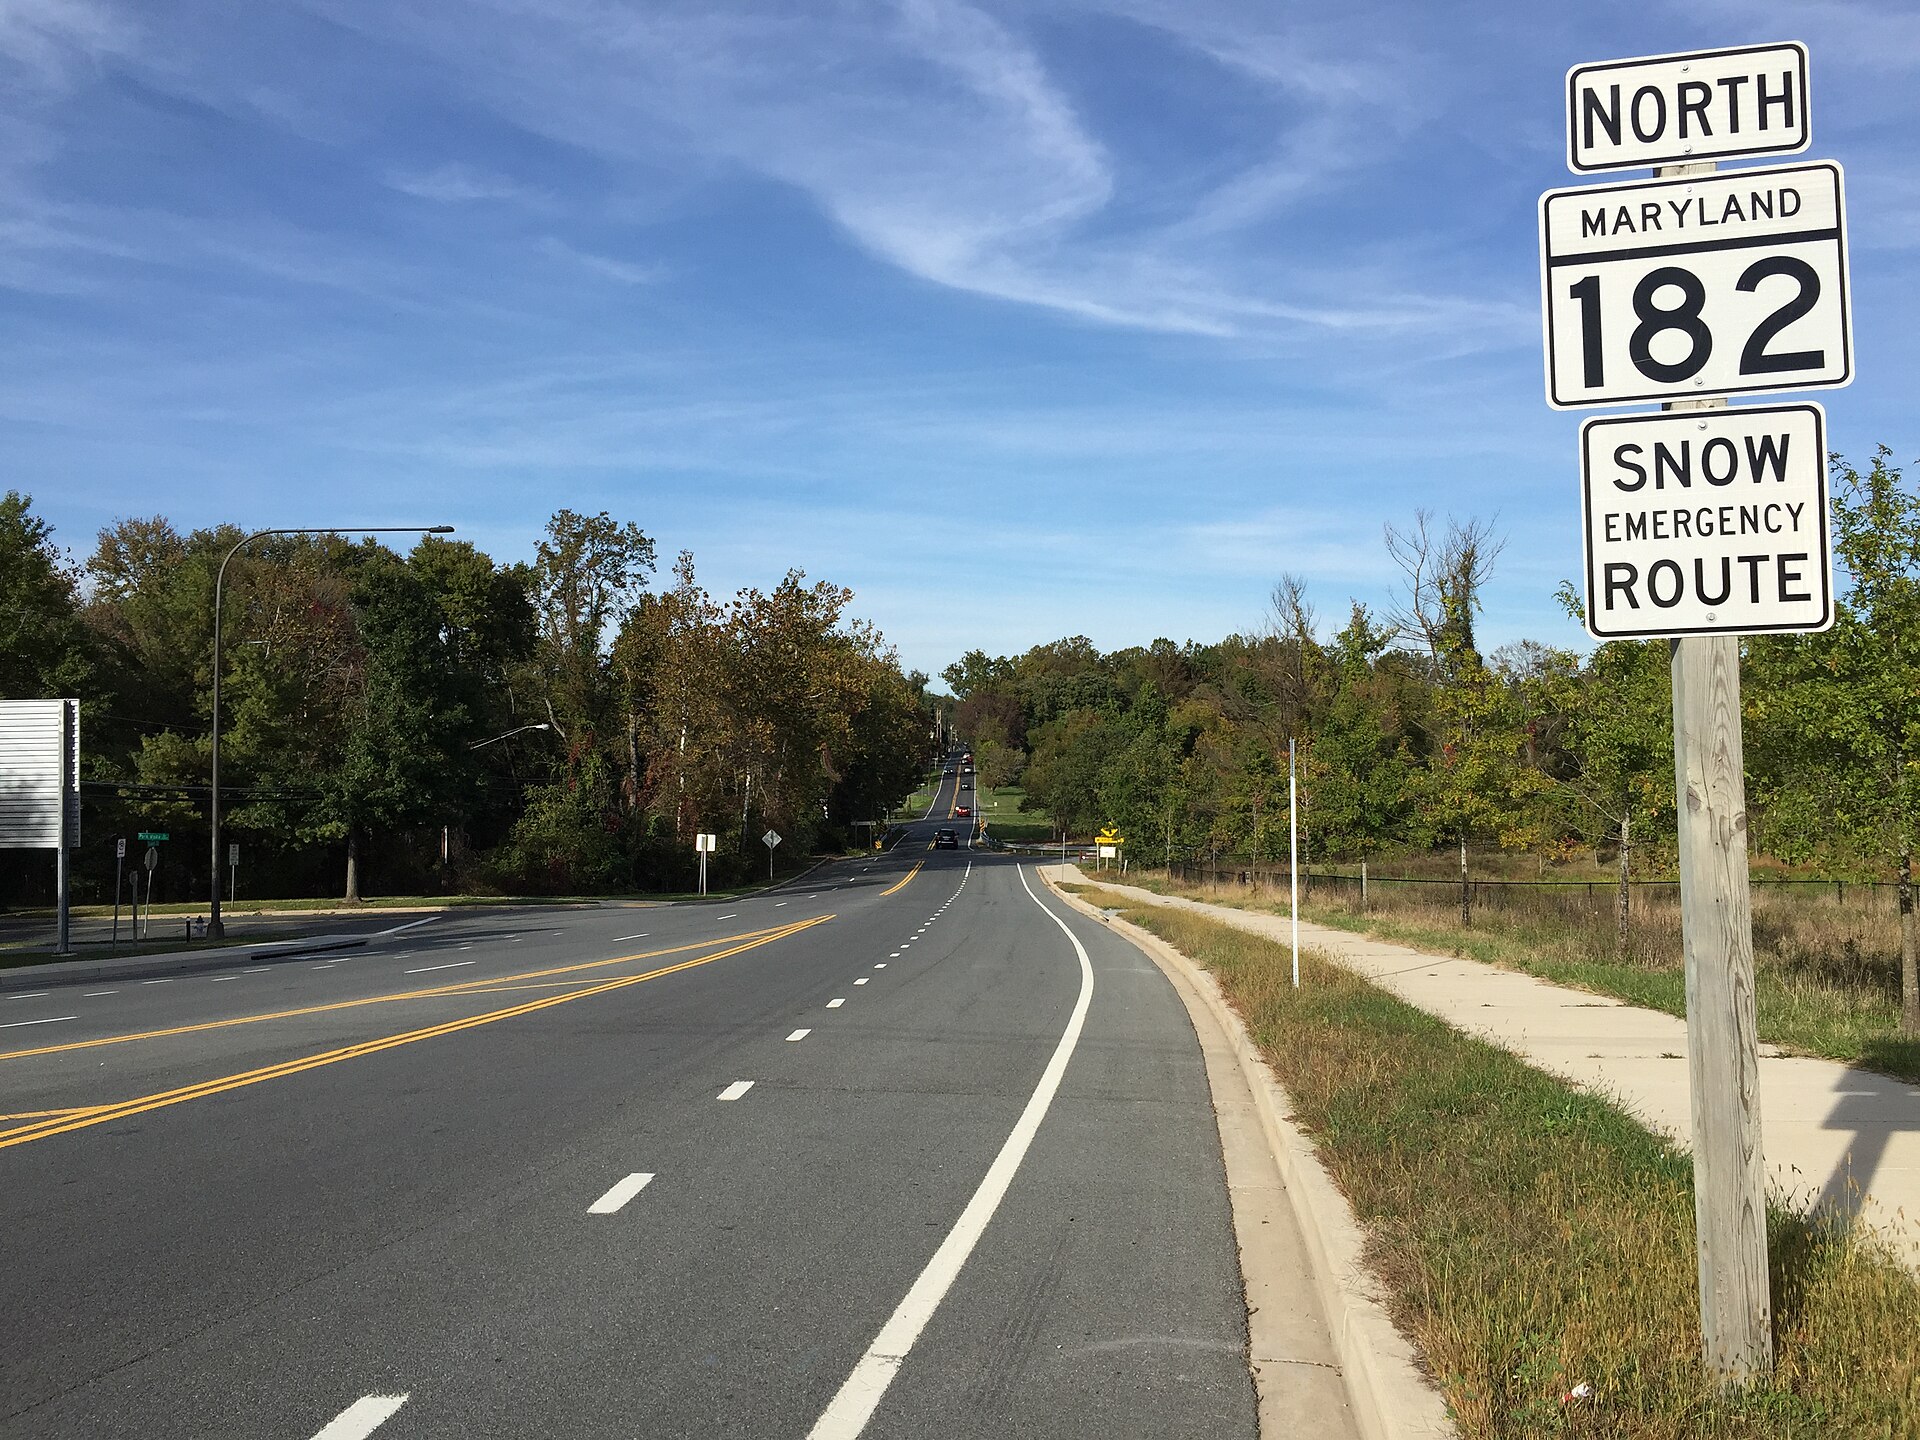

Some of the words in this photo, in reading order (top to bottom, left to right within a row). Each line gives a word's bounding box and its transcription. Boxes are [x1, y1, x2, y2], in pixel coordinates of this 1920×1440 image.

[1582, 70, 1795, 150] NORTH
[1581, 188, 1802, 238] MARYLAND
[1569, 255, 1826, 389] 182
[1612, 433, 1791, 493] SNOW
[1604, 502, 1805, 543] EMERGENCY
[1603, 552, 1812, 611] ROUTE
